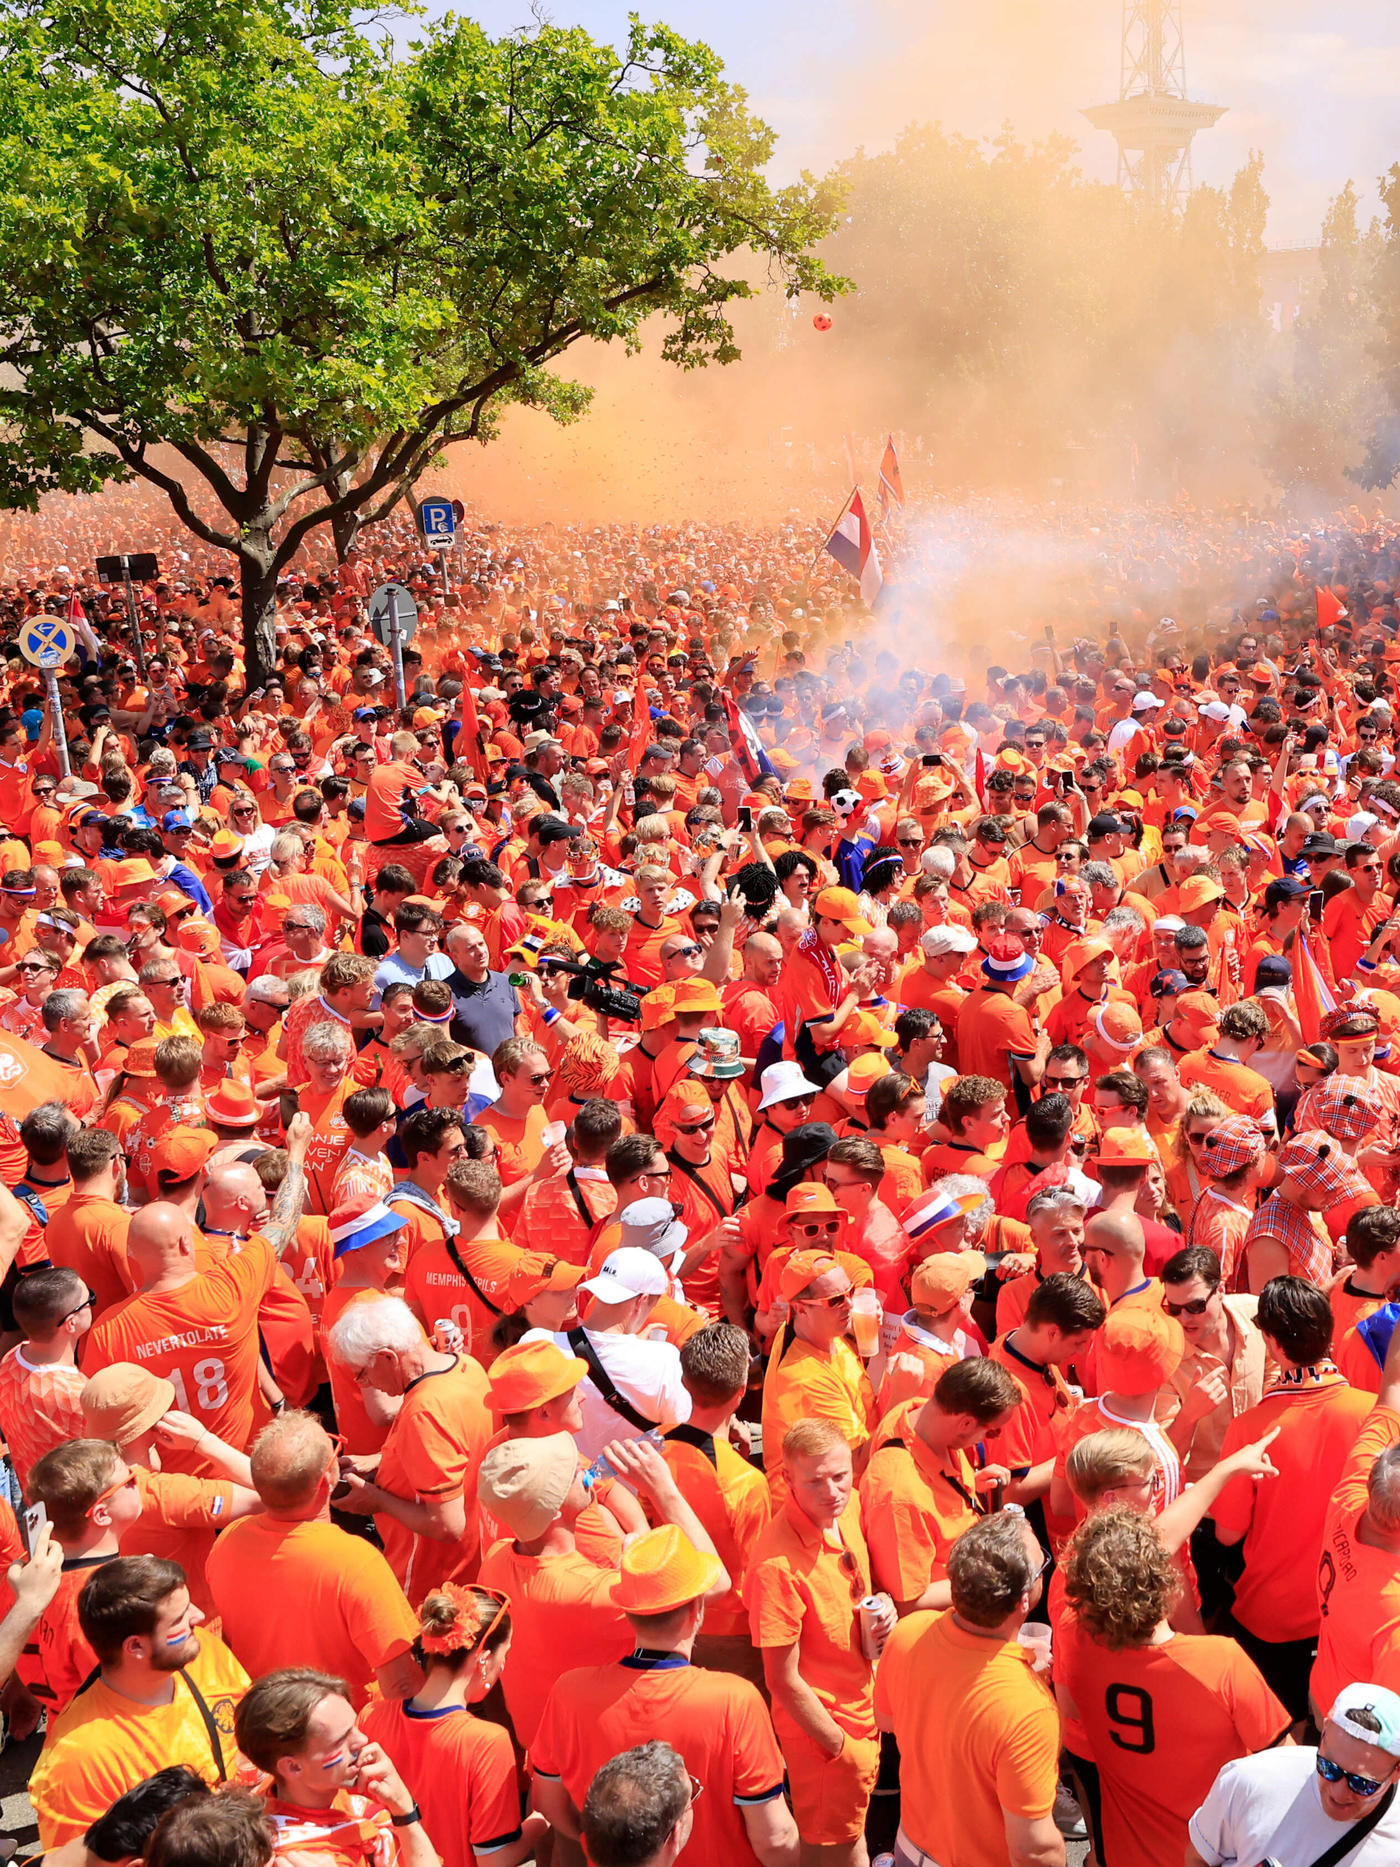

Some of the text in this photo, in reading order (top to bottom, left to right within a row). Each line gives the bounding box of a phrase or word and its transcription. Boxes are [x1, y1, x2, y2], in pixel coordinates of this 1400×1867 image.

[430, 508, 446, 531] P
[425, 1271, 497, 1293] MEMPHIS EPILS
[136, 1324, 230, 1359] NEVERTOLATE
[164, 1357, 229, 1414] 18
[1105, 1682, 1156, 1755] 9
